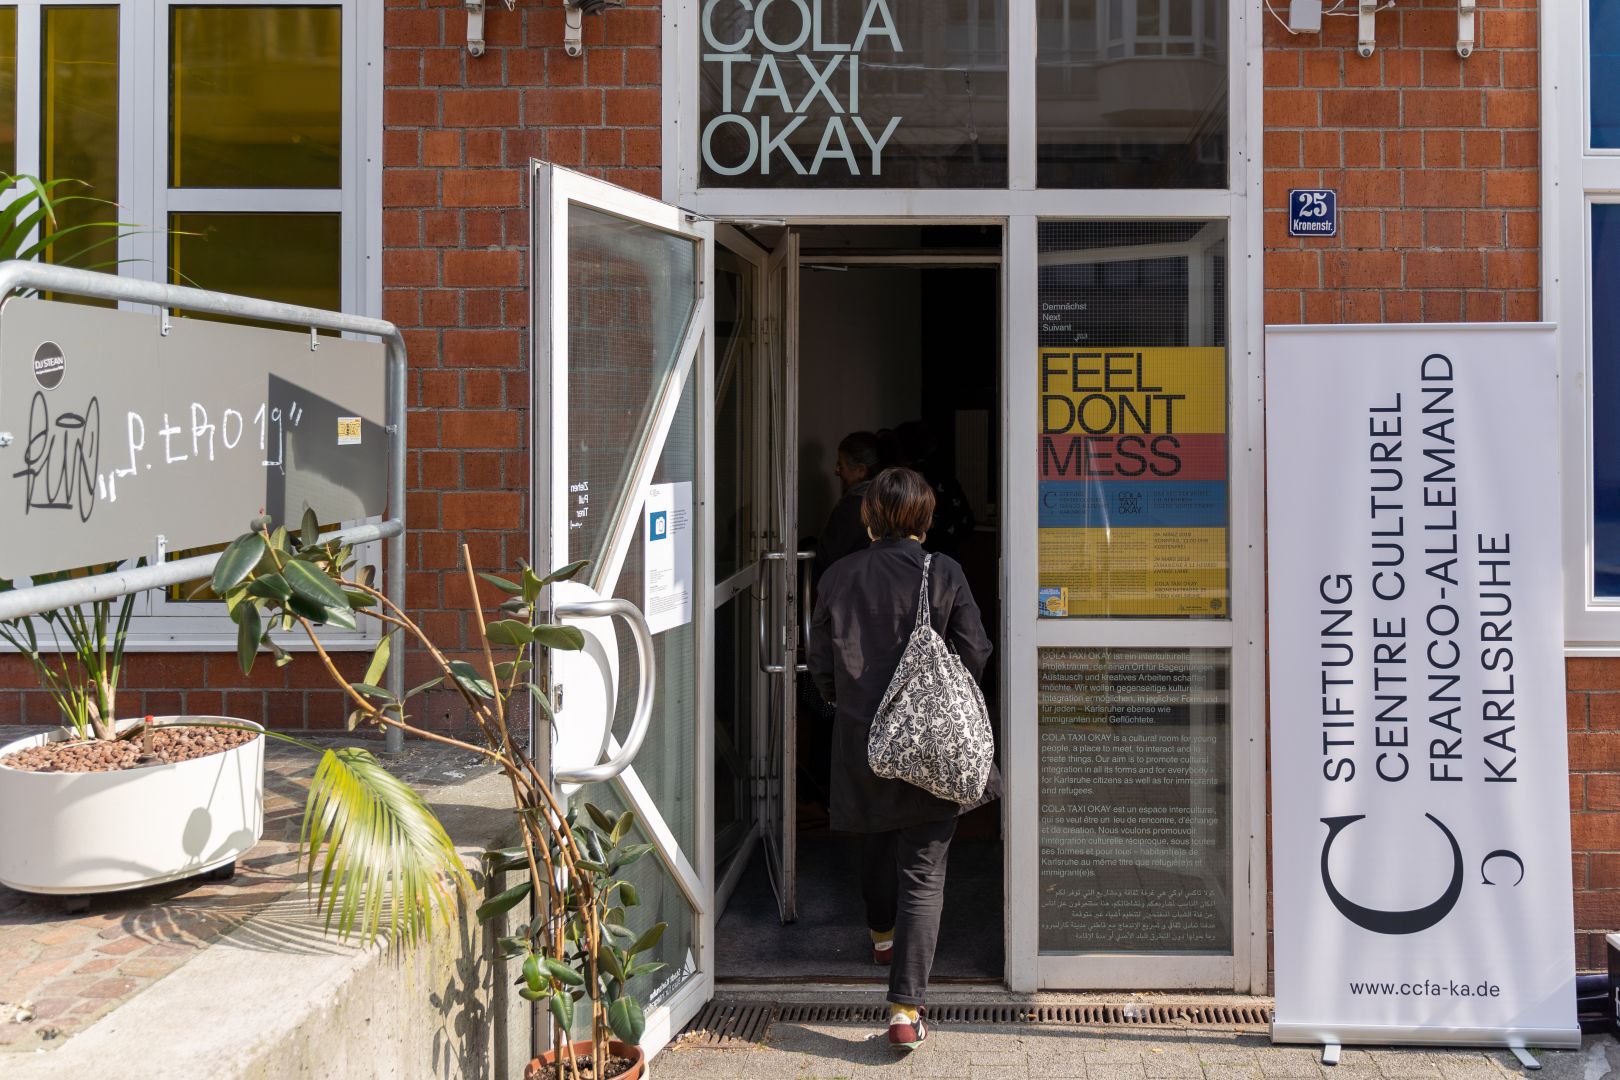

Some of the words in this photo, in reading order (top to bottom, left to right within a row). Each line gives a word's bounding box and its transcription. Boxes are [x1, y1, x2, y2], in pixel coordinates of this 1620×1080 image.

[702, 0, 903, 52] COLA
[703, 54, 859, 114] TAXI
[702, 114, 903, 176] OKAY
[1299, 193, 1327, 217] 25
[1293, 219, 1333, 231] Kronenstr.
[1042, 302, 1087, 310] Demnächst
[1042, 313, 1061, 321] Next
[1043, 352, 1162, 392] FEEL
[1043, 393, 1186, 434] DONT
[1043, 435, 1181, 477] MESS
[1369, 392, 1406, 601] CULTUREL
[1421, 353, 1464, 781] FRANCO-ALLEMAND
[1478, 533, 1517, 783] KARLSRUHE
[1085, 673, 1099, 681] und
[1319, 573, 1355, 782] STIFTUNG
[1373, 617, 1410, 782] CENTRE
[1041, 734, 1066, 742] COLA
[1068, 734, 1086, 742] TAXI
[1088, 734, 1112, 742] OKAY
[1080, 745, 1101, 754] place
[1145, 745, 1175, 753] interact
[1041, 766, 1083, 774] integration
[1115, 766, 1137, 774] forms
[1146, 756, 1178, 764] promote
[1054, 776, 1090, 784] Karlsruhe
[1092, 776, 1122, 784] citizens
[1350, 979, 1501, 998] www.ccfa-ka.de
